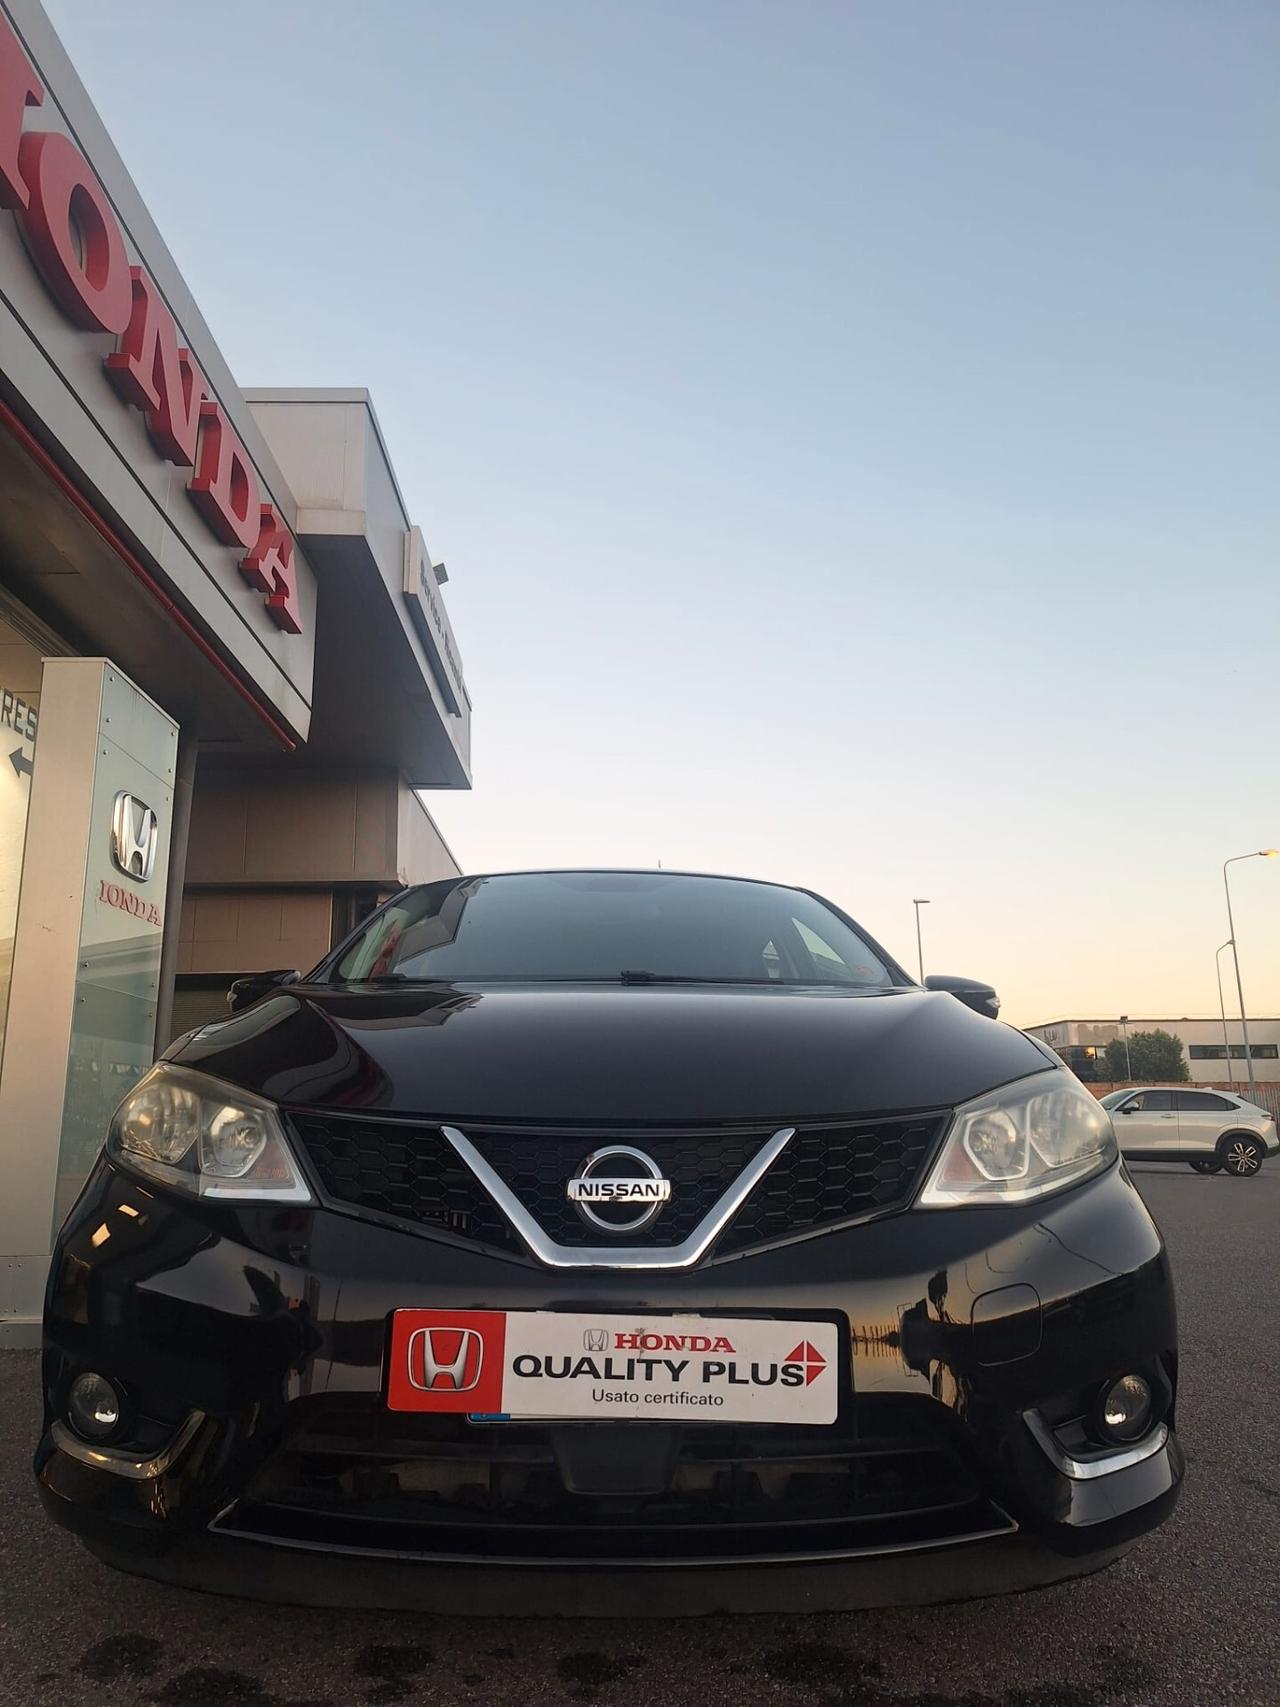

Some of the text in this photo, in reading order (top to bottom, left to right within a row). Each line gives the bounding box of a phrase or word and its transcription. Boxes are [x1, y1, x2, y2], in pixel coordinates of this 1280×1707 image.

[578, 1183, 660, 1197] NISSAN
[614, 1332, 737, 1353] HONDA
[512, 1354, 805, 1387] QUALITY PLUS
[592, 1388, 724, 1406] Usato certificato
